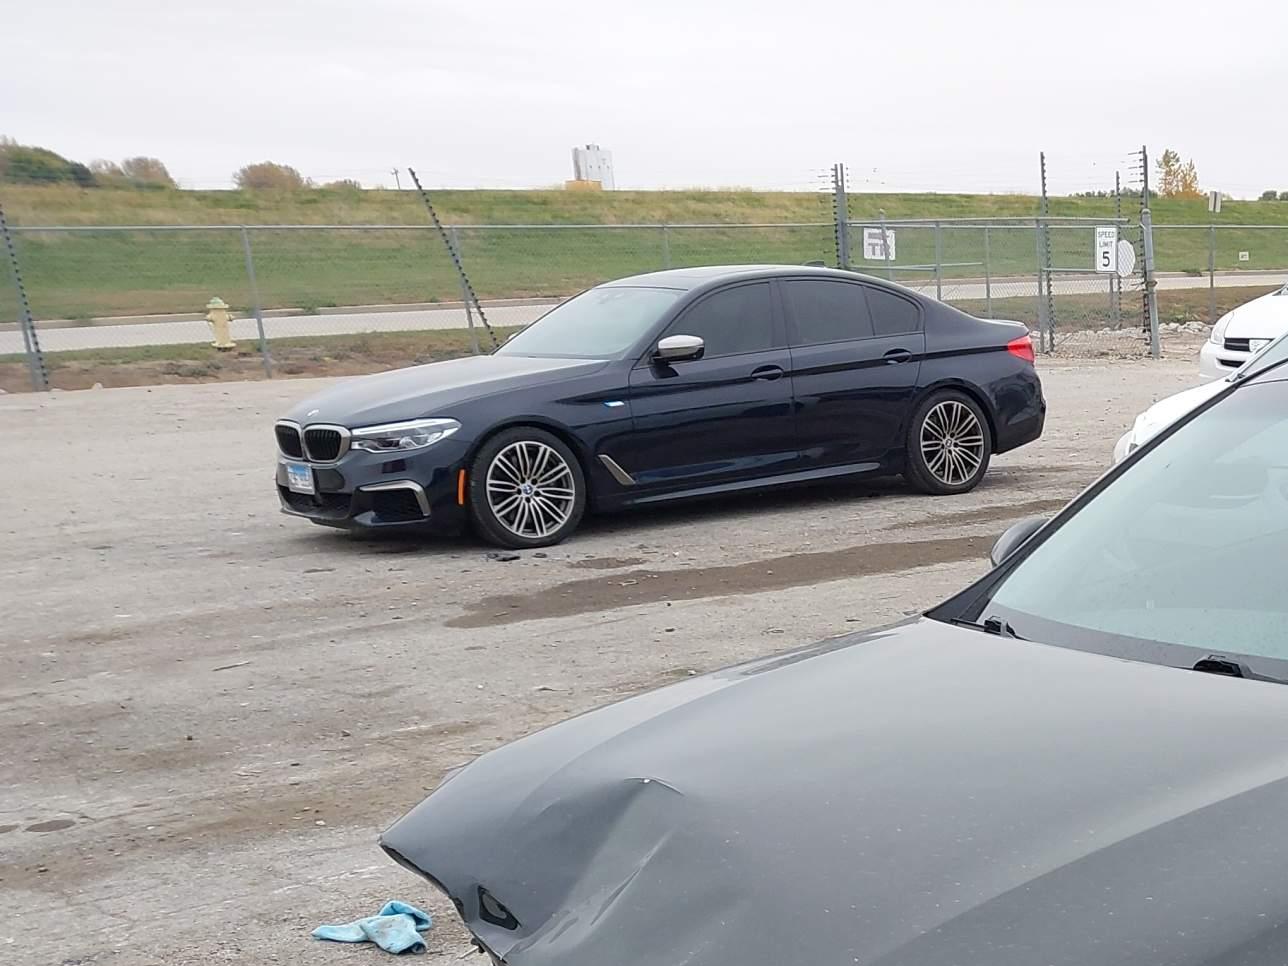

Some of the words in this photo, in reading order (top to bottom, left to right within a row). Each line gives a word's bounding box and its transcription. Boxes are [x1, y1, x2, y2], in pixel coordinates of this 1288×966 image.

[1097, 231, 1115, 239] SPEED
[1098, 241, 1113, 249] LIMIT
[1102, 251, 1110, 267] 5
